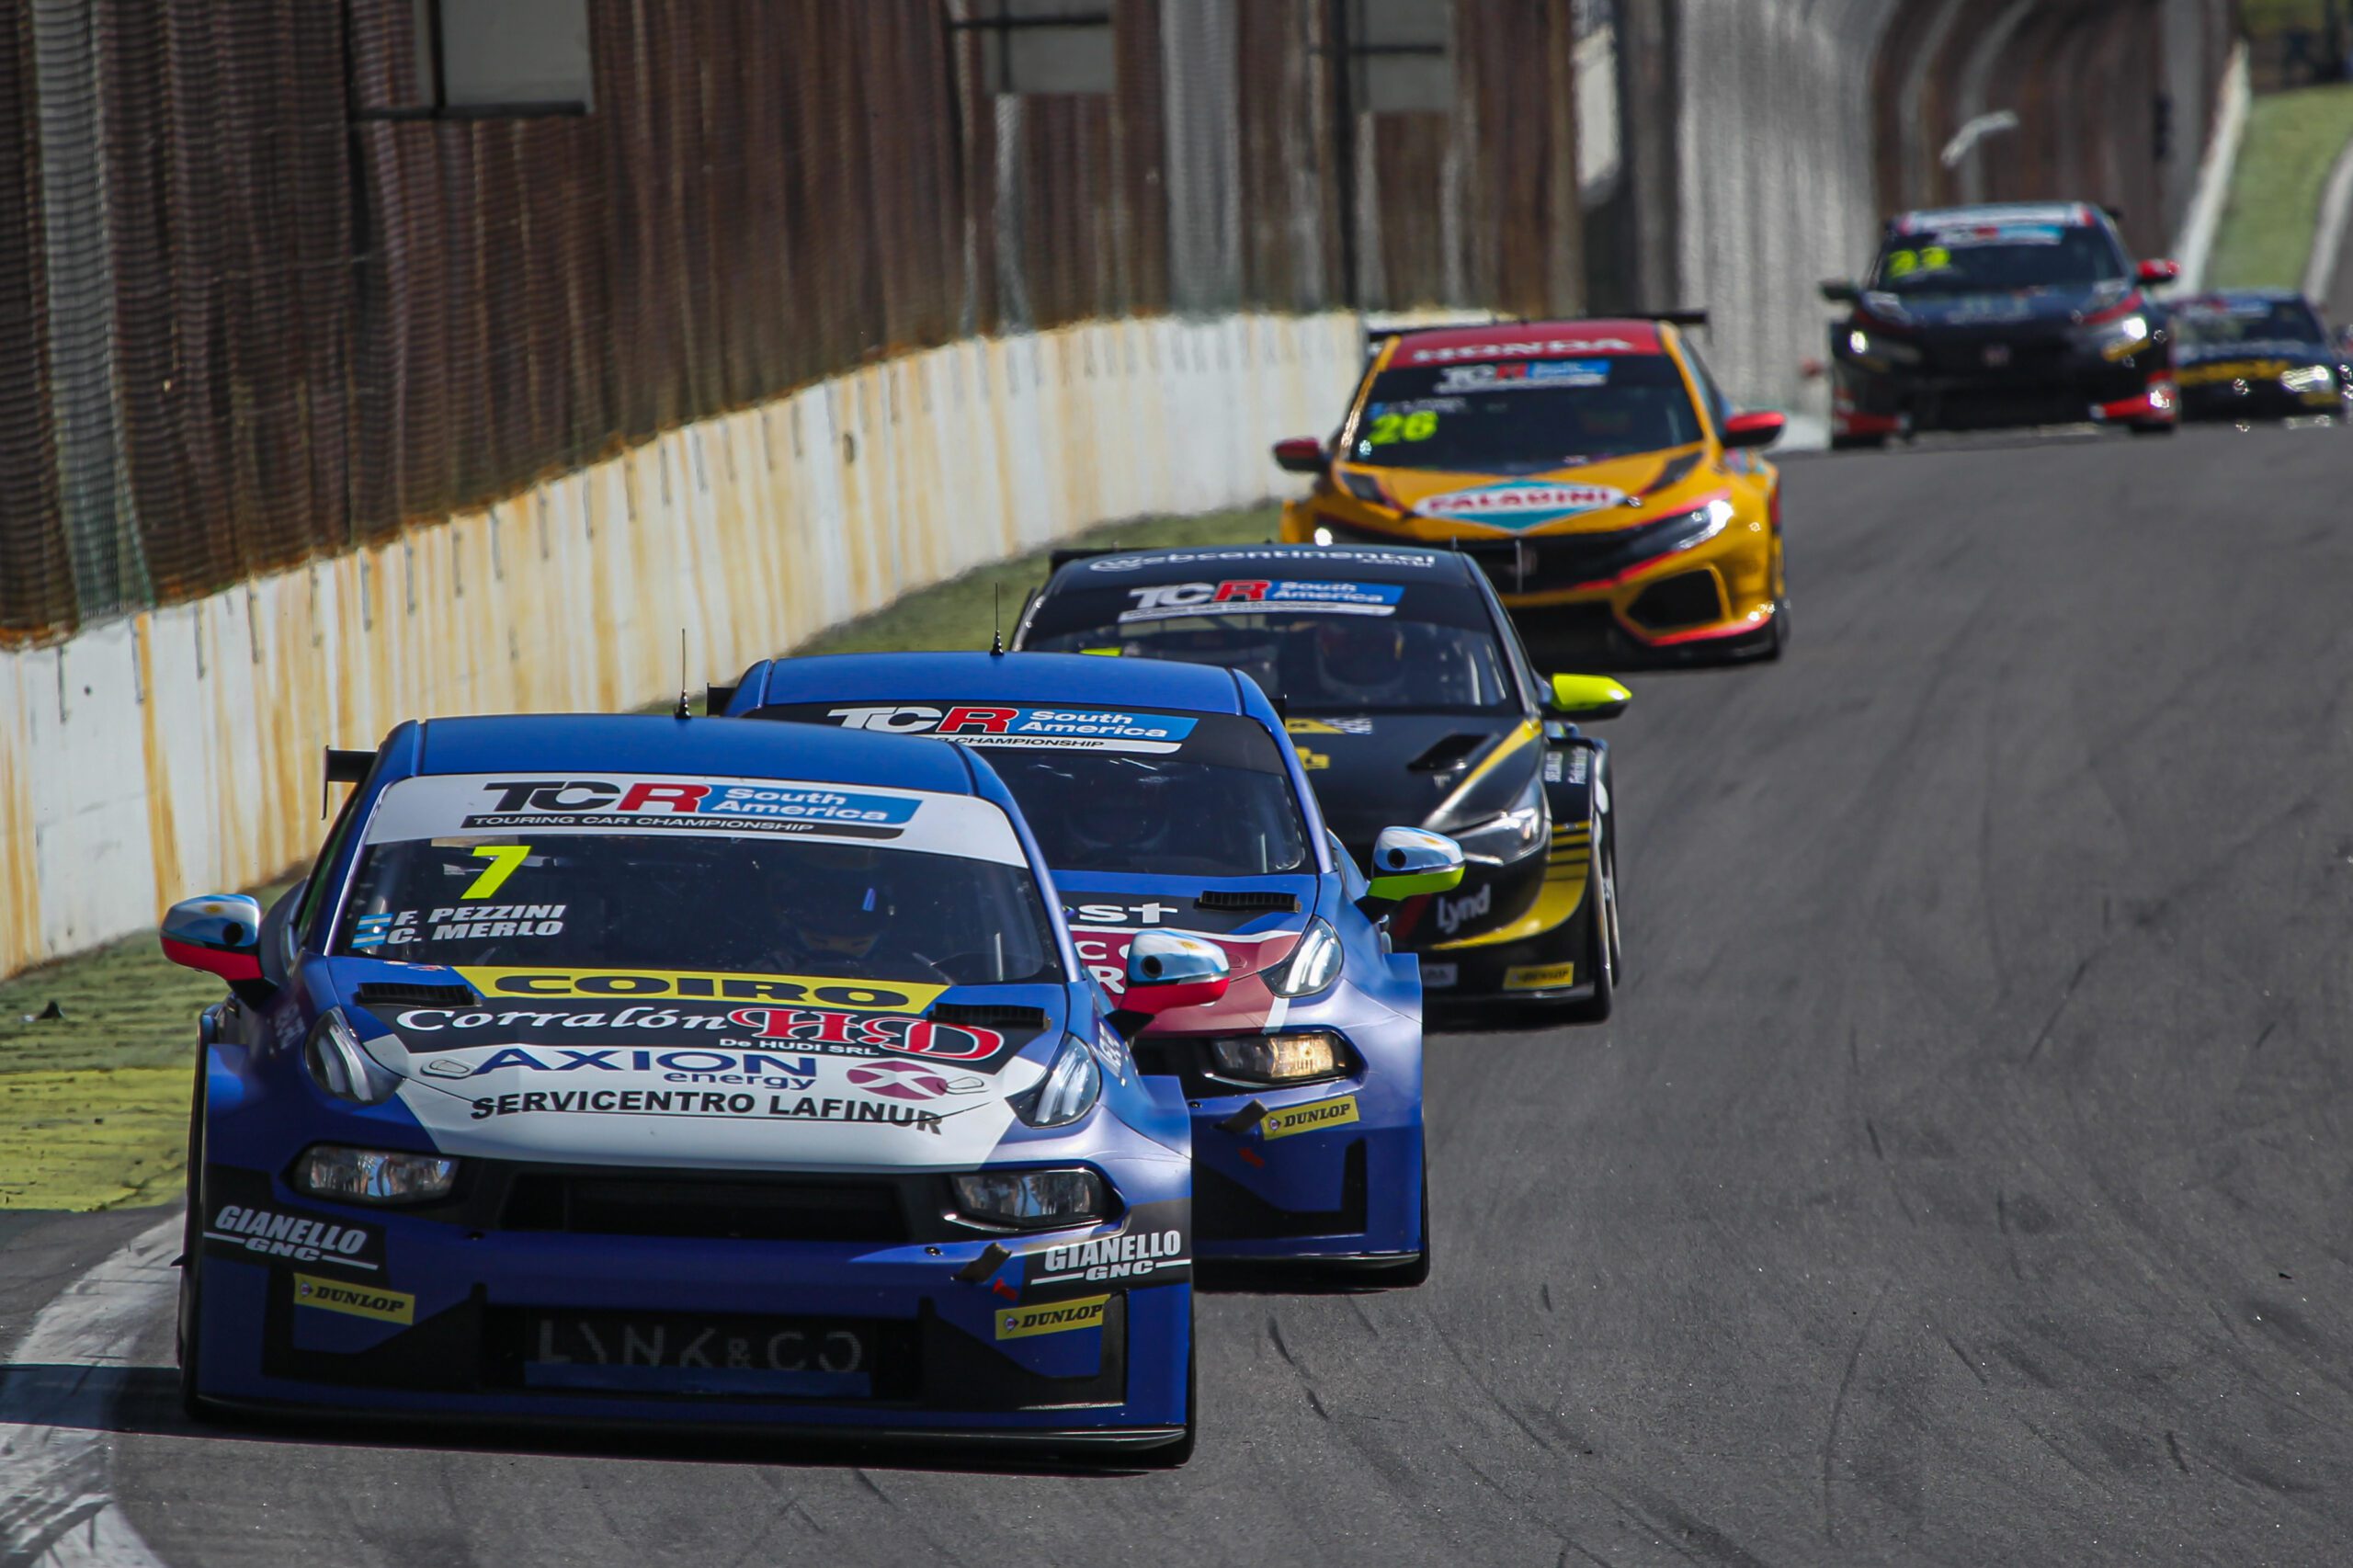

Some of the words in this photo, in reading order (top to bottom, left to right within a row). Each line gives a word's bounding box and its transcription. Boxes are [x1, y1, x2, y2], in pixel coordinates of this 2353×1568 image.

[1128, 580, 1271, 608] TCR
[1273, 590, 1384, 604] America
[1279, 581, 1358, 593] South
[828, 707, 1019, 733] TCR
[1029, 710, 1134, 724] South
[960, 736, 1105, 747] CHAMPIONSHIP
[1017, 722, 1167, 738] America
[483, 781, 710, 812] TCR
[724, 788, 847, 805] South
[711, 800, 888, 821] America
[473, 815, 574, 826] TOURING
[582, 816, 631, 825] CAR
[636, 817, 814, 832] CHAMPIONSHIP
[460, 846, 531, 899] 7
[393, 910, 418, 926] F.
[427, 904, 567, 923] PEZZINI
[387, 927, 422, 945] C.
[432, 920, 563, 940] MERLO
[494, 975, 909, 1007] COIRO
[396, 1006, 728, 1031] Corralón
[720, 1038, 752, 1047] De
[759, 1040, 821, 1051] HUDI
[828, 1045, 879, 1056] SRL
[472, 1048, 816, 1077] AXION
[663, 1072, 816, 1091] energy
[471, 1090, 756, 1119] SERVICENTRO
[768, 1095, 942, 1135] LAFINUR
[1284, 1104, 1350, 1128] DUNLOP
[215, 1205, 367, 1255] GIANELLO
[244, 1237, 320, 1261] GNC
[1045, 1230, 1181, 1271] GIANELLO
[1086, 1260, 1154, 1281] GNC
[314, 1286, 404, 1312] DUNLOP
[1021, 1304, 1103, 1328] DUNLOP
